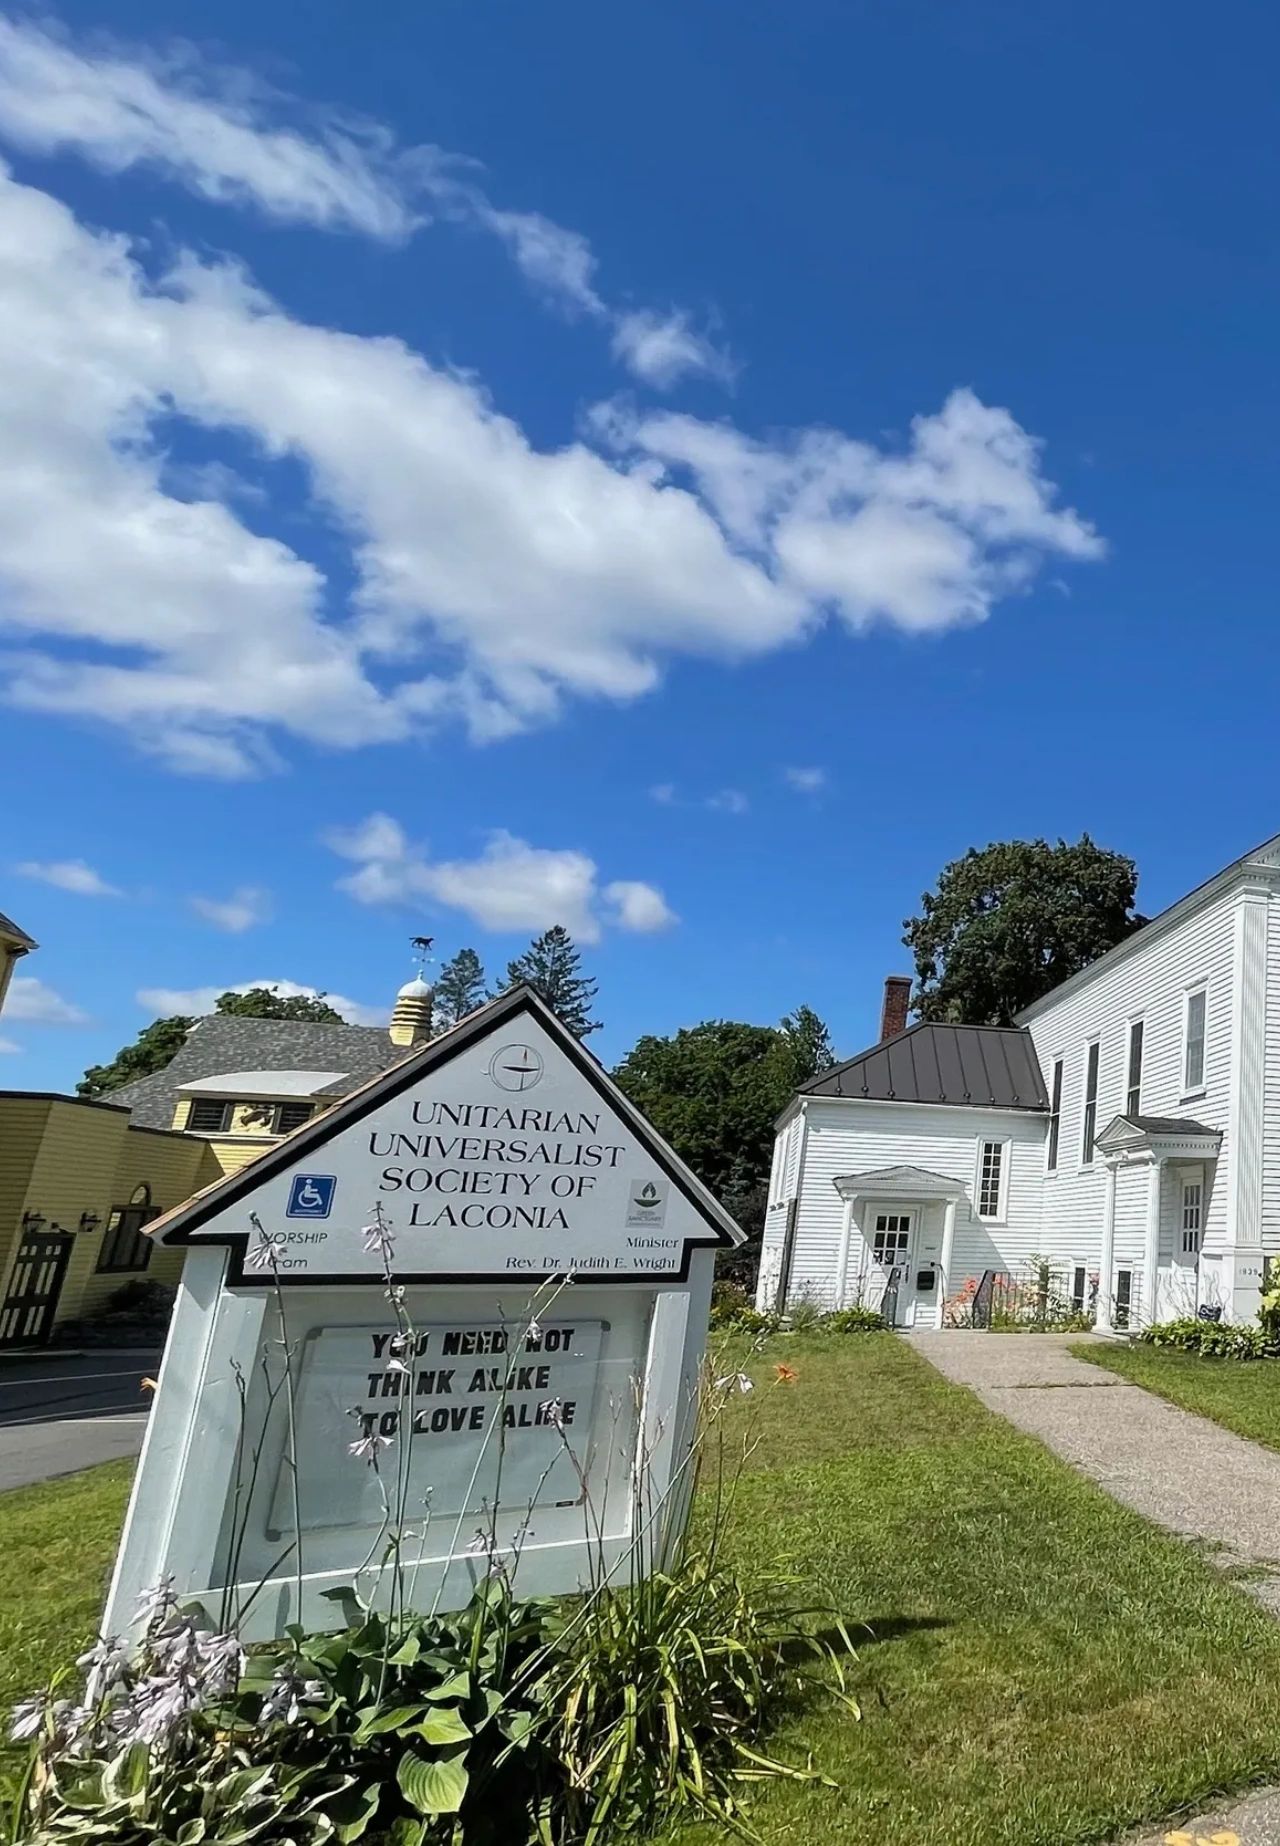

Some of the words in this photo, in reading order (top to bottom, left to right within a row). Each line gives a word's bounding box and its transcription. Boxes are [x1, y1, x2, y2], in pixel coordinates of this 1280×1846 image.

[411, 1101, 600, 1135] UNITARIAN
[368, 1132, 626, 1168] UNIVERSALIST
[378, 1166, 542, 1196] SOCIETY
[551, 1174, 598, 1198] OF
[408, 1202, 570, 1229] LACONIA
[259, 1232, 328, 1244] WORSHIP
[626, 1236, 679, 1249] Minister
[282, 1259, 308, 1269] am
[506, 1256, 537, 1269] Rev.
[542, 1256, 562, 1269] Dr.
[567, 1256, 610, 1269] Judith
[614, 1256, 628, 1269] E.
[633, 1256, 676, 1271] Wright
[371, 1331, 430, 1358] YOU
[442, 1331, 509, 1356] NEED
[525, 1328, 575, 1353] NOT
[367, 1369, 456, 1398] THINK
[467, 1366, 551, 1393] ALIKE
[360, 1410, 399, 1438] TO
[412, 1405, 485, 1434] LOVE
